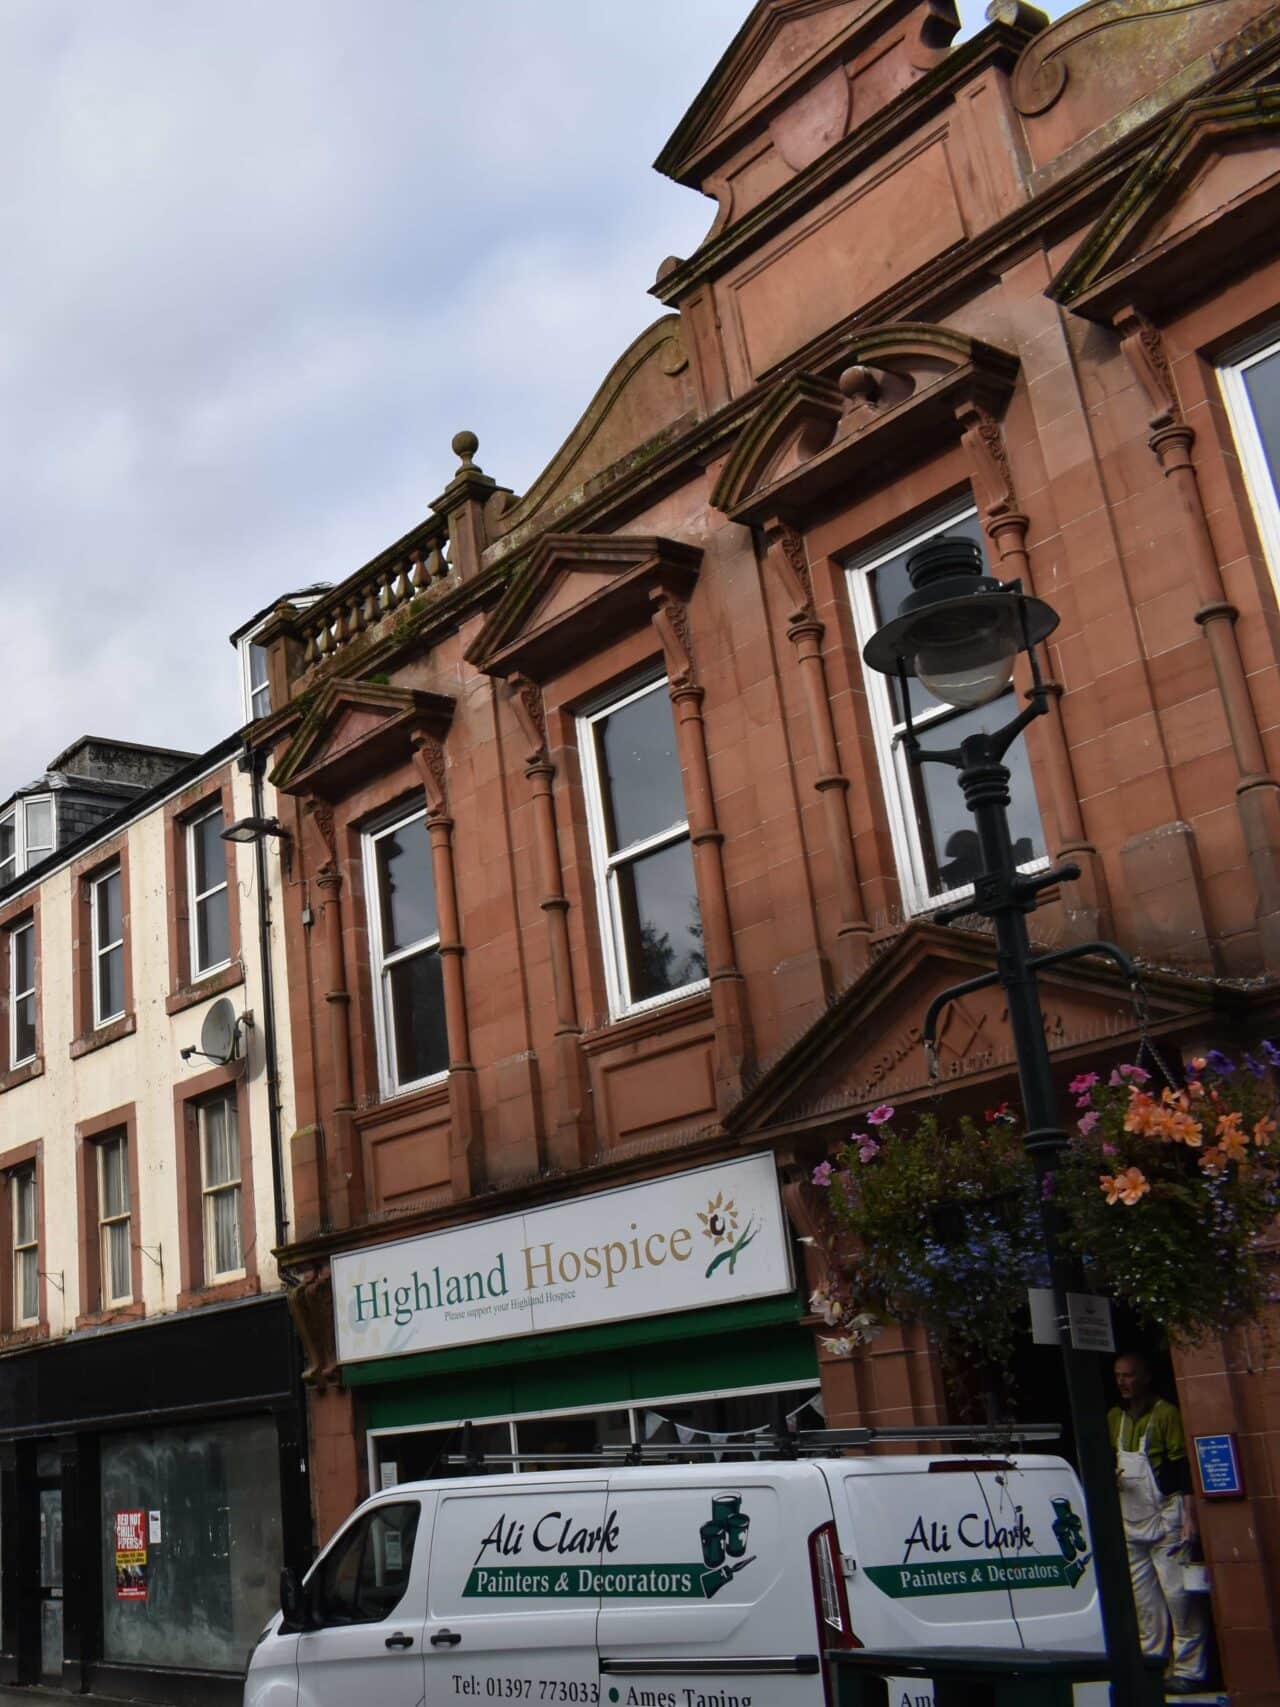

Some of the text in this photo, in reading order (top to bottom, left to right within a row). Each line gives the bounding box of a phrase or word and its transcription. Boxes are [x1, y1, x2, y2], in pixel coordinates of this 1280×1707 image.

[352, 1223, 693, 1326] Highland Hospice
[444, 1290, 577, 1322] Please support your Highland Hospice
[473, 1509, 621, 1565] Ali Clark
[903, 1511, 1034, 1564] Ali Clark
[477, 1568, 692, 1594] Painters & Decorators
[900, 1562, 1060, 1589] Painters & Decorators
[453, 1674, 601, 1704] Tel: 01397 773033
[626, 1686, 752, 1707] Ames Taping
